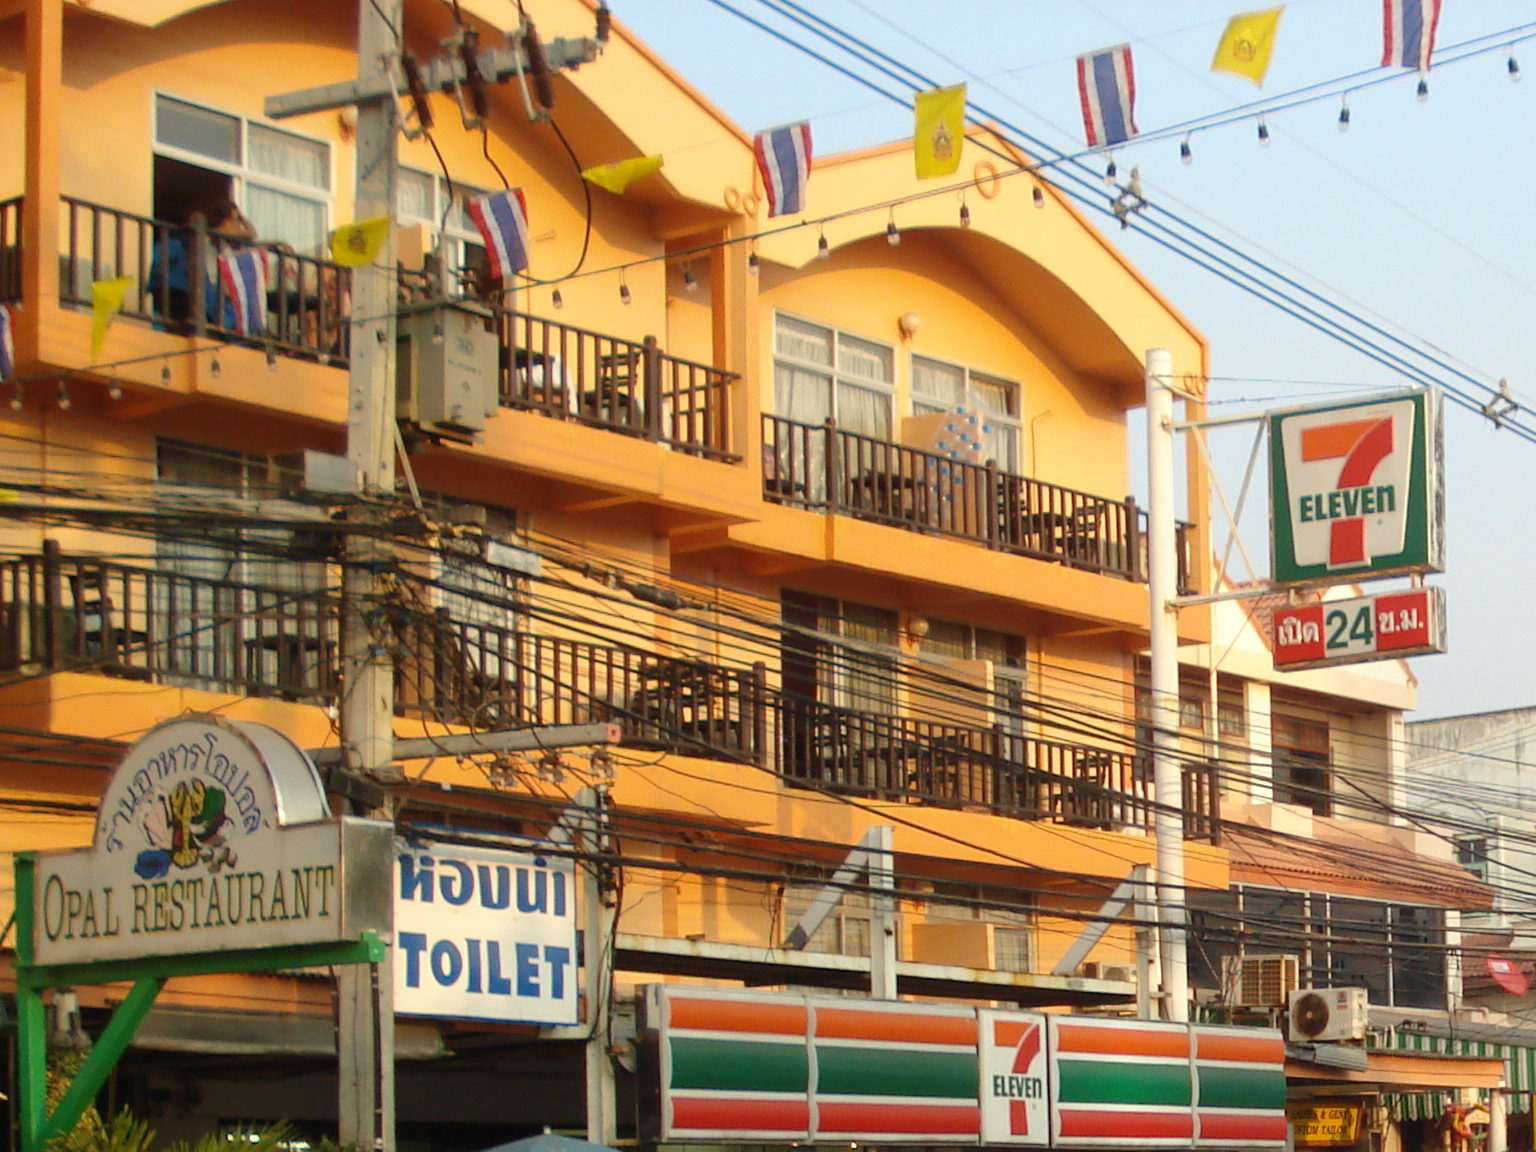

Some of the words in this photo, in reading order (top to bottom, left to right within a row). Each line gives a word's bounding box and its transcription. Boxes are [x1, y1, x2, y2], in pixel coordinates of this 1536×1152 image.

[1301, 416, 1394, 565] 7
[1278, 613, 1319, 646] เปิด
[1326, 605, 1373, 650] 24
[44, 874, 120, 942] OPAL
[131, 865, 334, 935] RESTAURANT
[398, 931, 570, 999] TOILET
[994, 1020, 1040, 1136] 7
[1322, 1125, 1347, 1134] TAILOR
[1329, 1110, 1347, 1119] GENT
